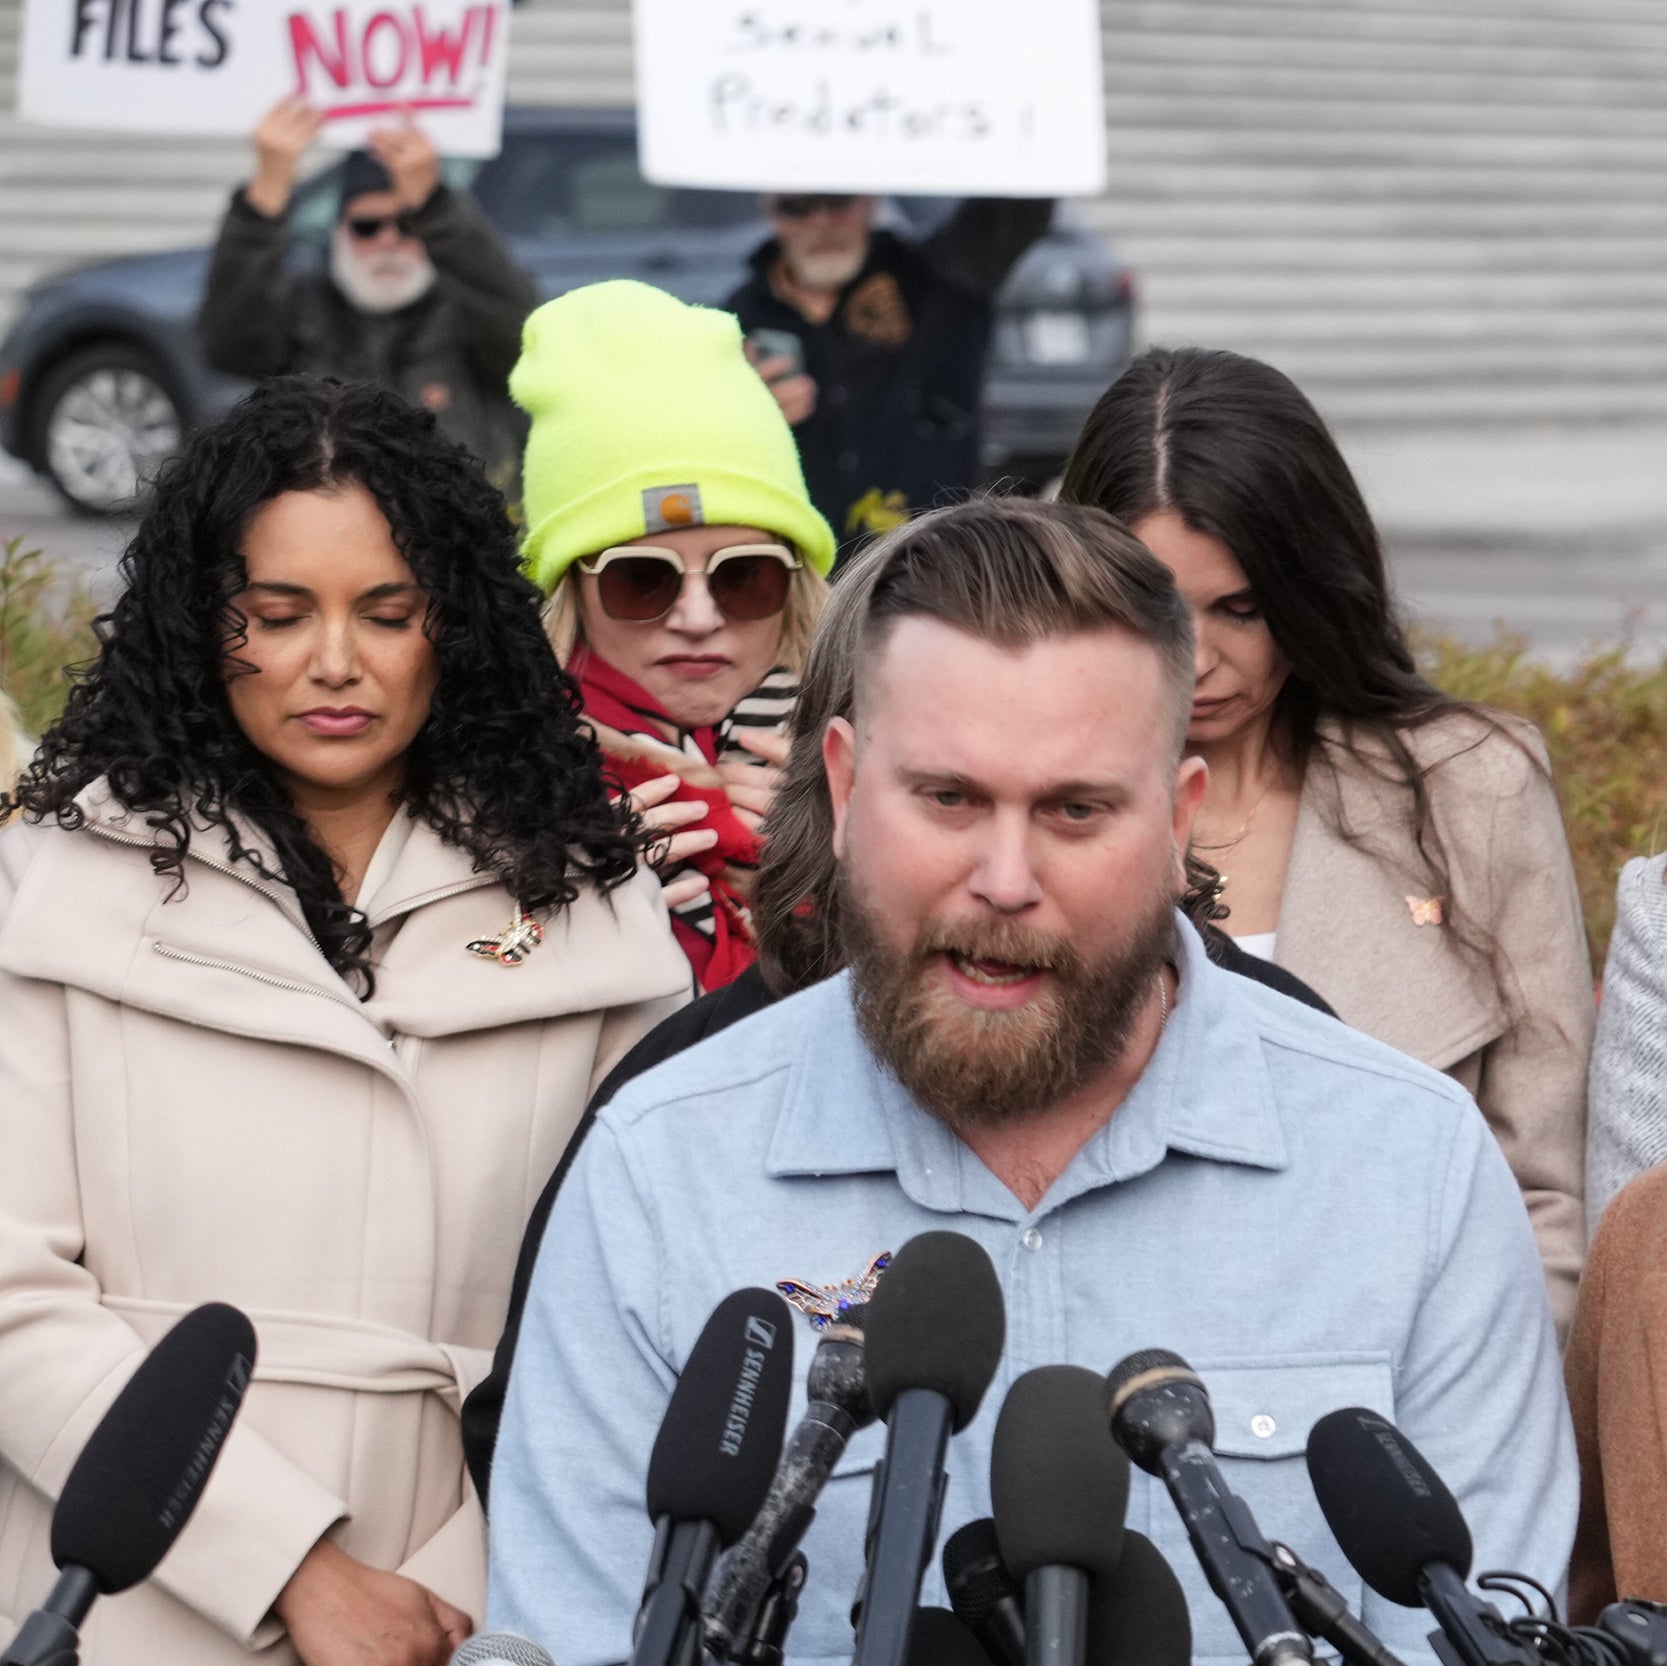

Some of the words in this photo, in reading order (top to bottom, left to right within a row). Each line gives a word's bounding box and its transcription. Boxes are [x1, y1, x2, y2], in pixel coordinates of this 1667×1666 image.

[70, 0, 230, 67] FILES
[287, 5, 497, 94] NOW!
[718, 1347, 766, 1457] SENNHEISER
